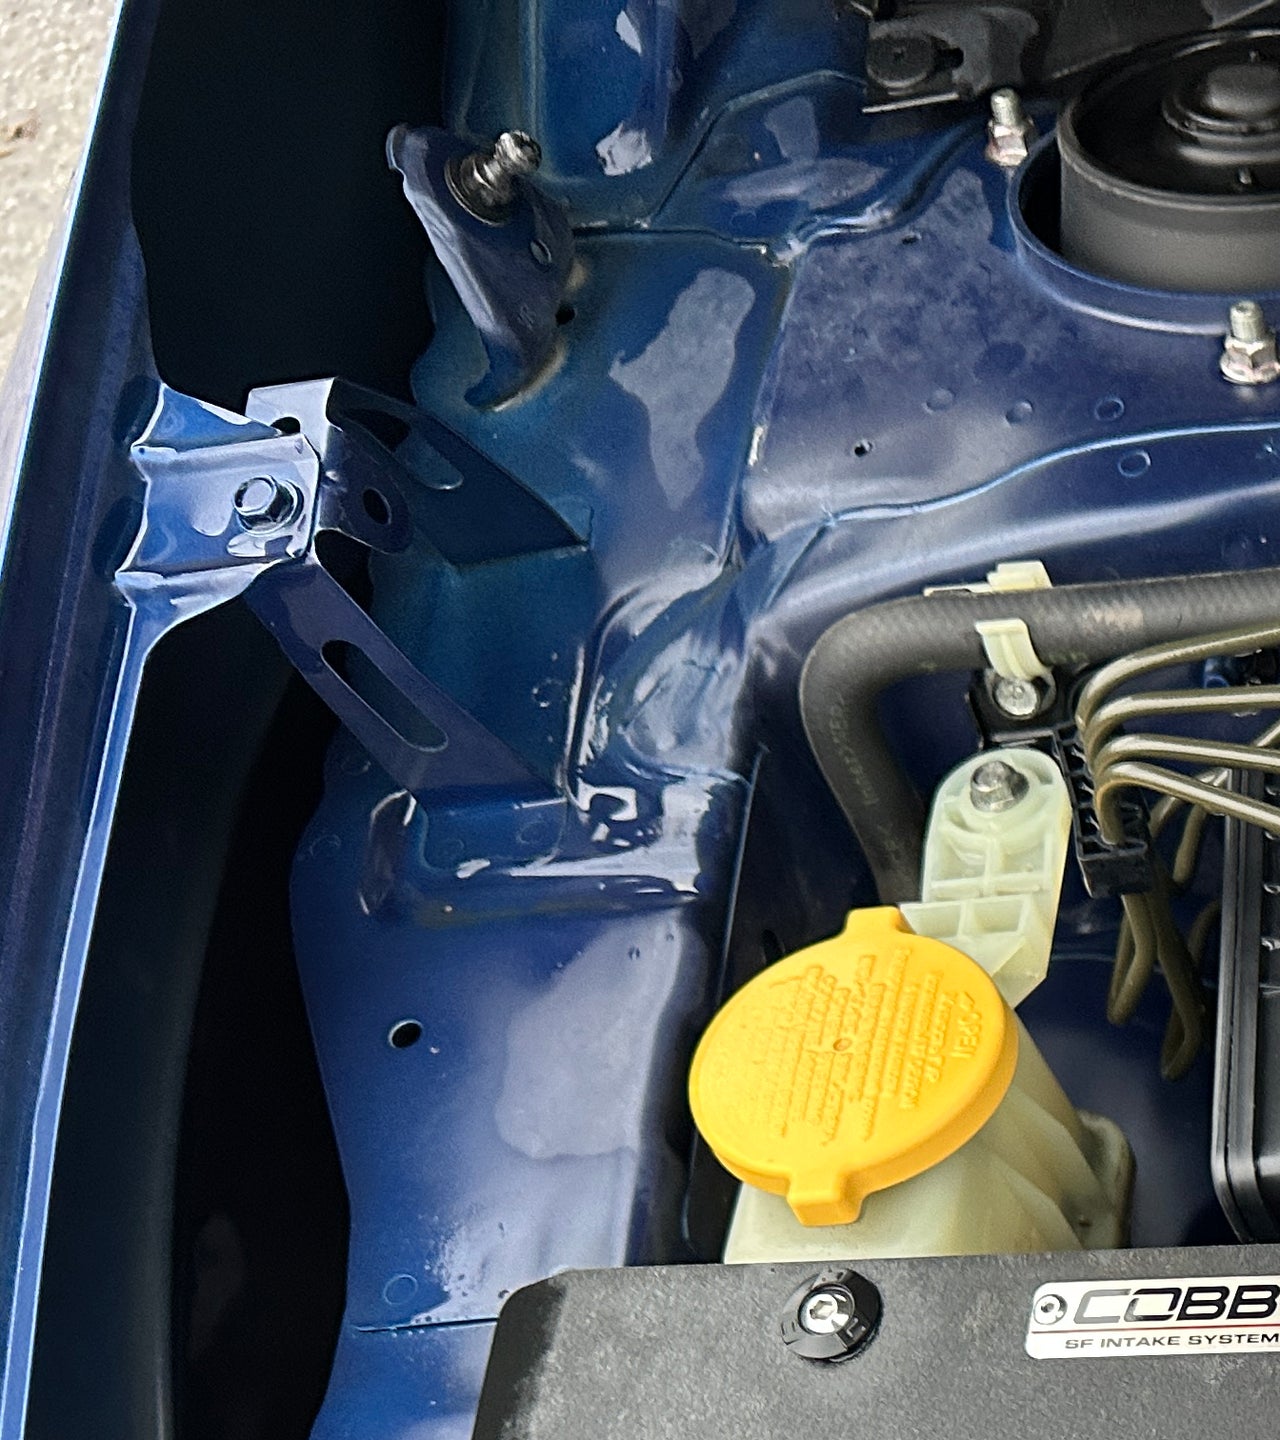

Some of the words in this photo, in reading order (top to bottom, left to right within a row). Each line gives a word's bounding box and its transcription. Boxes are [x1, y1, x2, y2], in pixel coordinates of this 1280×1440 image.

[1064, 1338, 1094, 1350] SF
[1100, 1336, 1181, 1348] INTAKE
[1188, 1333, 1280, 1345] SYSTEM
